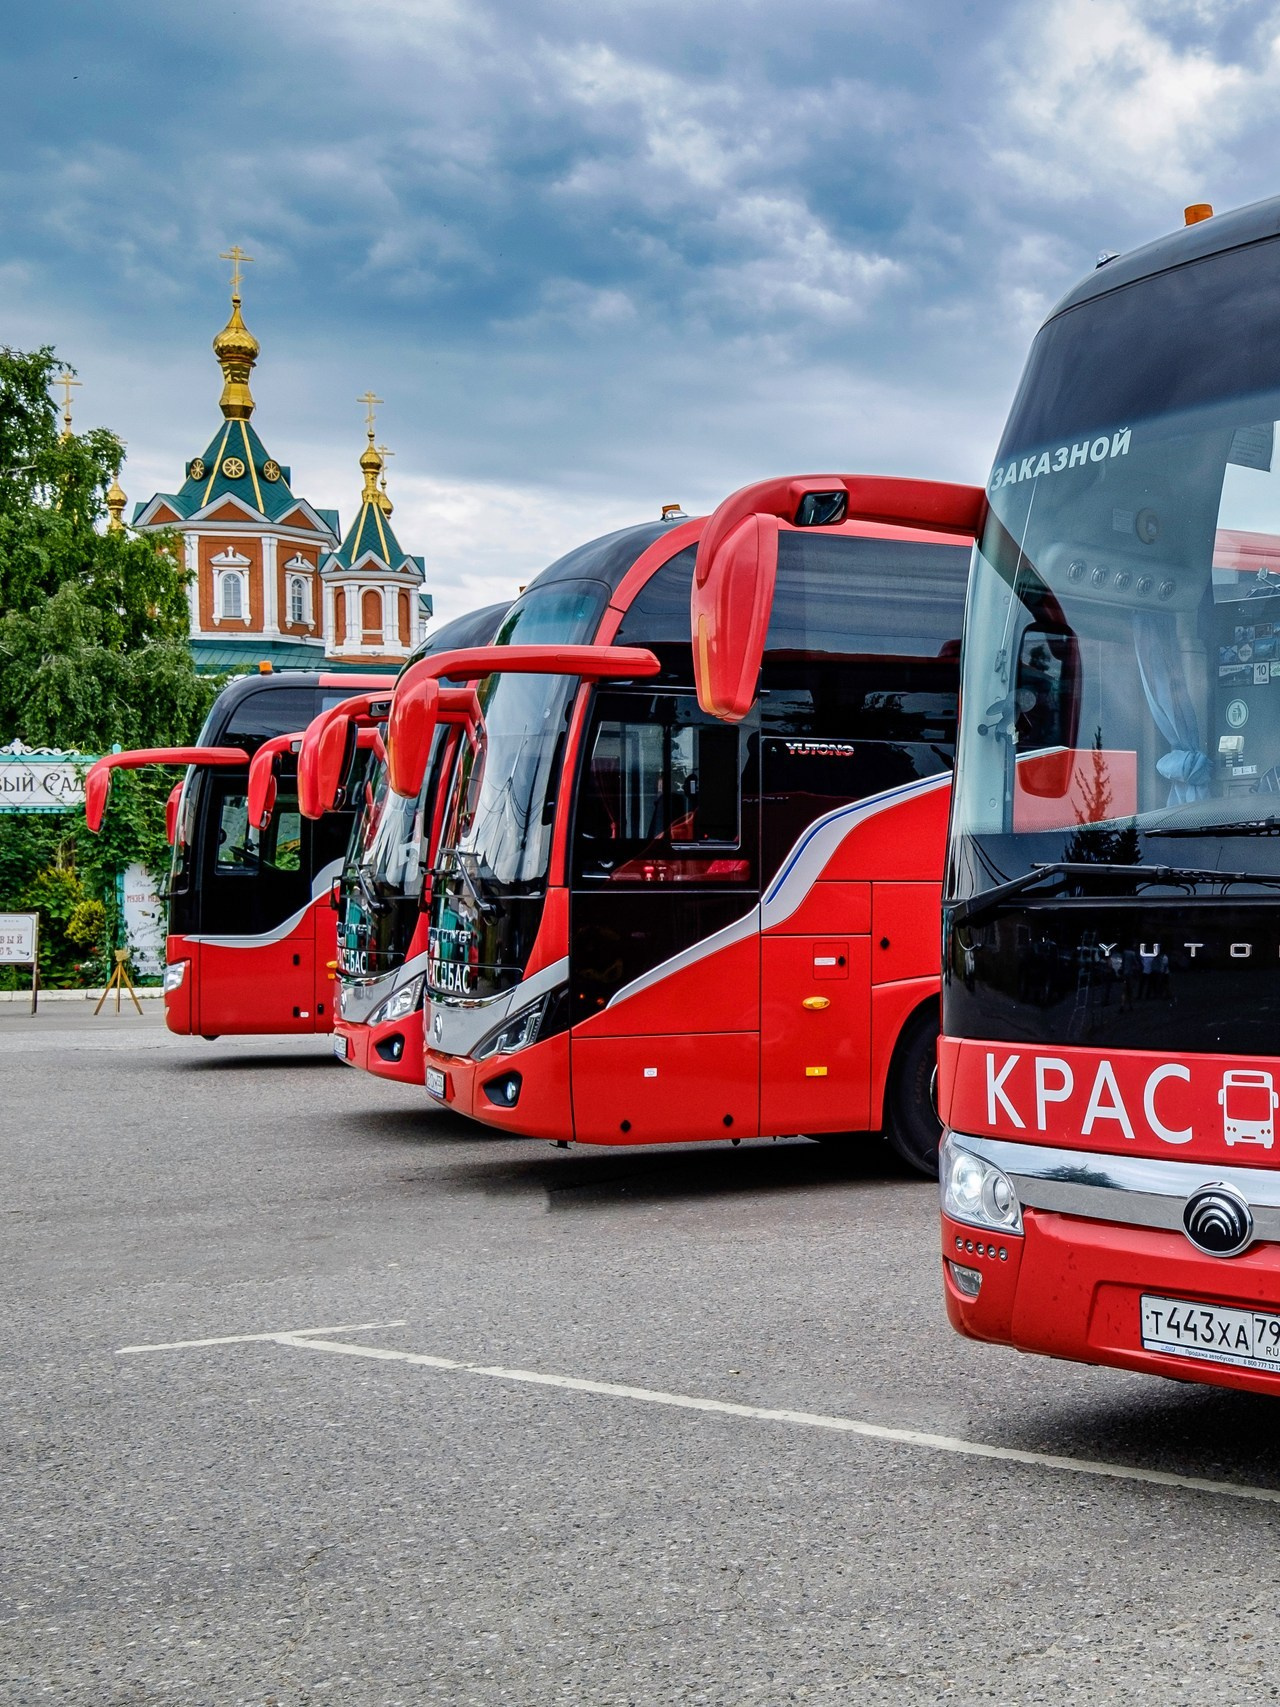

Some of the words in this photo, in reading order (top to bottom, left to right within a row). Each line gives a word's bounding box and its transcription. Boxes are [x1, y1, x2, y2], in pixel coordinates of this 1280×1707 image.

[991, 426, 1132, 492] ЗАКАЗНОЙ
[1256, 664, 1267, 676] 10
[785, 742, 855, 757] YUTONG
[350, 950, 367, 974] БАС
[448, 962, 471, 994] БАС
[985, 1052, 1193, 1145] КРАС
[1185, 1348, 1209, 1359] Продажа
[1209, 1353, 1234, 1363] автобусов
[1257, 1360, 1267, 1368] 777
[1268, 1362, 1275, 1370] 12
